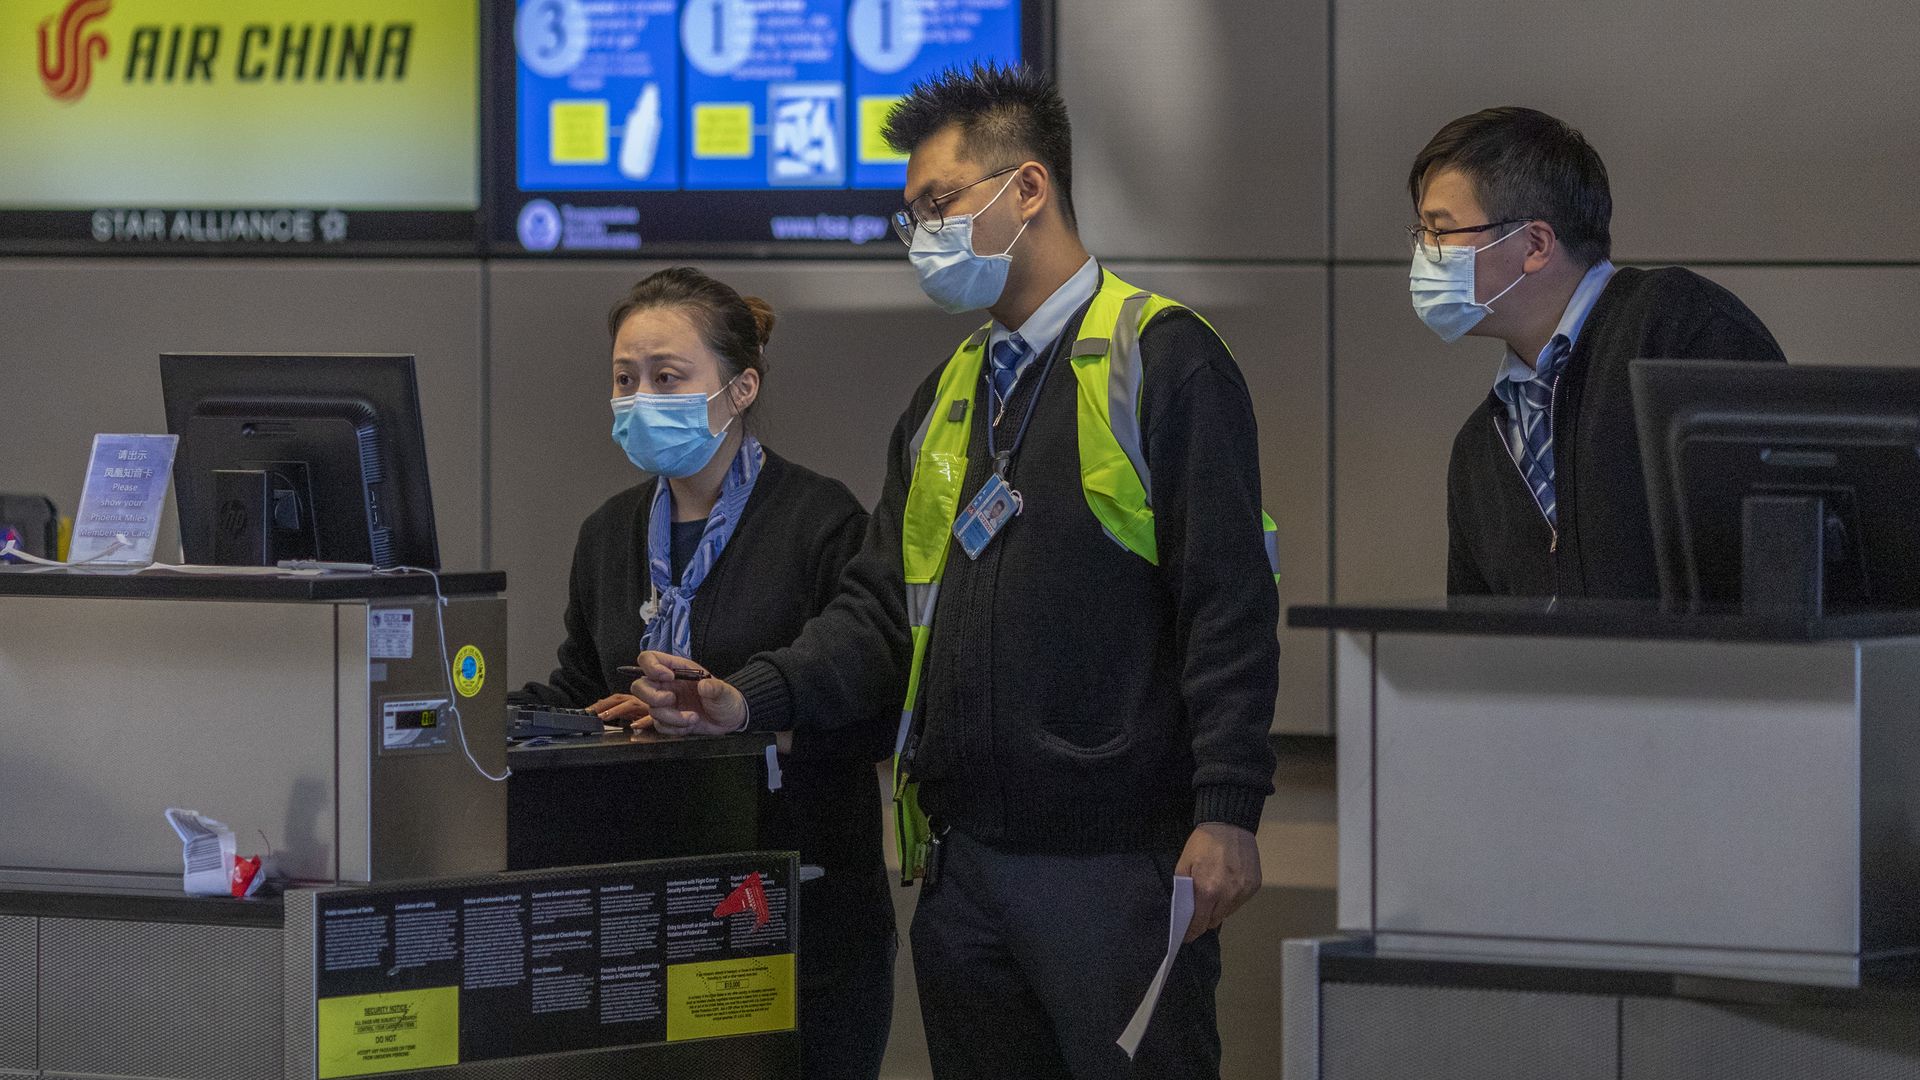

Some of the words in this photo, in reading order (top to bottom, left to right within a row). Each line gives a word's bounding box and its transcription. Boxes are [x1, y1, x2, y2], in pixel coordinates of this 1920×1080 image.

[123, 24, 220, 83] AIR
[233, 23, 414, 83] CHINA
[92, 211, 166, 242] STAR
[171, 210, 315, 242] ALLIANCE
[112, 483, 138, 492] Please
[101, 498, 122, 507] show
[124, 499, 144, 508] your
[90, 513, 122, 522] Phoenix
[124, 513, 147, 522] Miles
[131, 528, 151, 538] Card
[364, 1006, 389, 1016] SECURITY
[375, 1035, 384, 1044] DO
[385, 1034, 397, 1043] NOT
